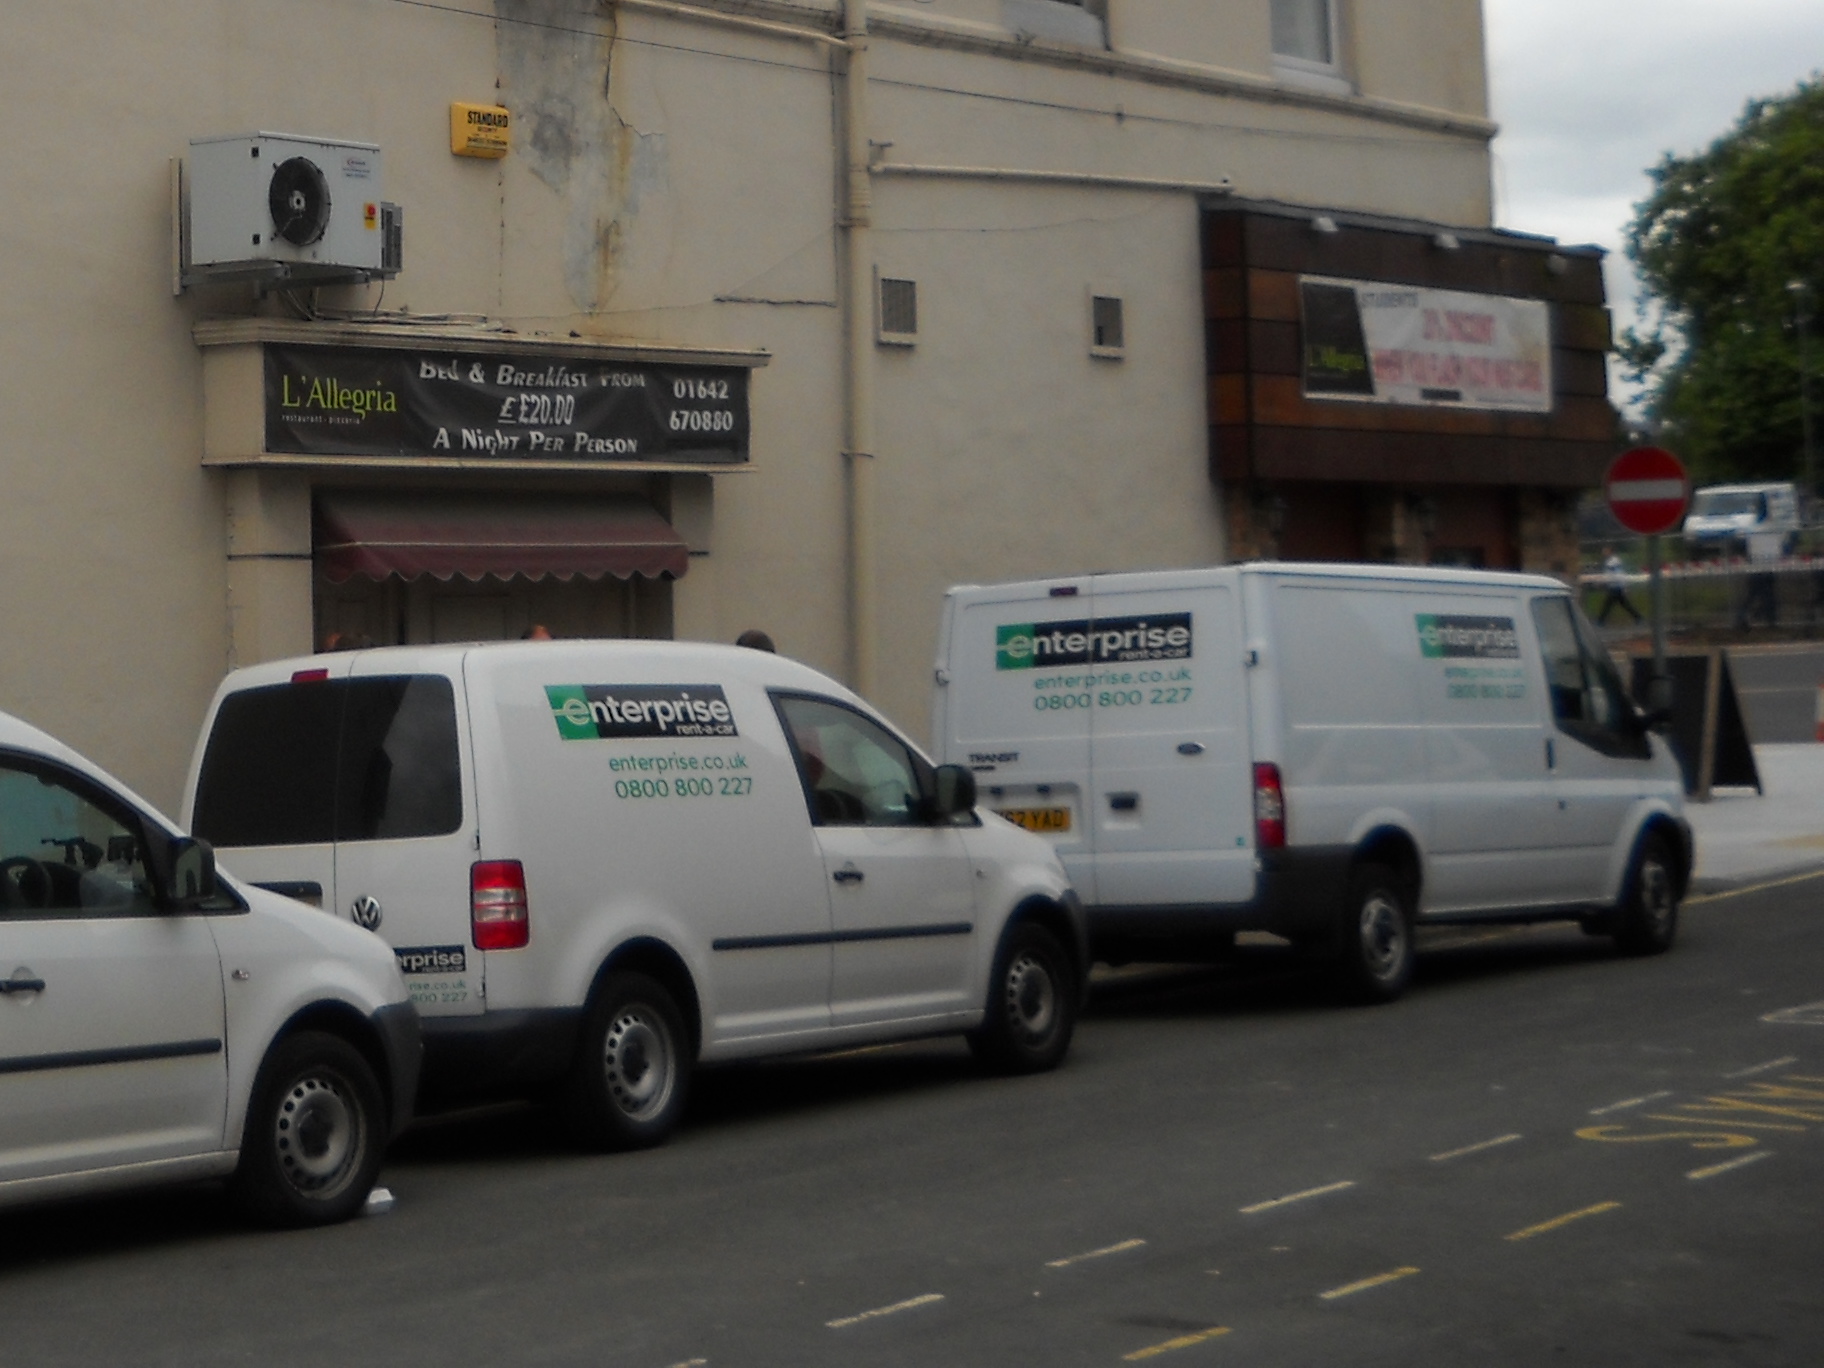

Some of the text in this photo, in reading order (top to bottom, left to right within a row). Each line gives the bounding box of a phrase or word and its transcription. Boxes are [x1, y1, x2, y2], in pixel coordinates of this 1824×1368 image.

[468, 362, 486, 384] &
[281, 374, 398, 420] L'Allegria
[673, 378, 729, 400] 01642
[668, 409, 734, 432] 670880
[433, 428, 451, 450] A
[998, 622, 1190, 659] enterprise
[1034, 666, 1193, 690] enterprise.co.uk
[1034, 686, 1194, 711] 0800 800 227
[556, 692, 731, 732] enterprise
[675, 723, 736, 737] rent-a-car
[608, 751, 748, 776] enterprise.co.uk
[614, 776, 753, 799] 0800 800 227
